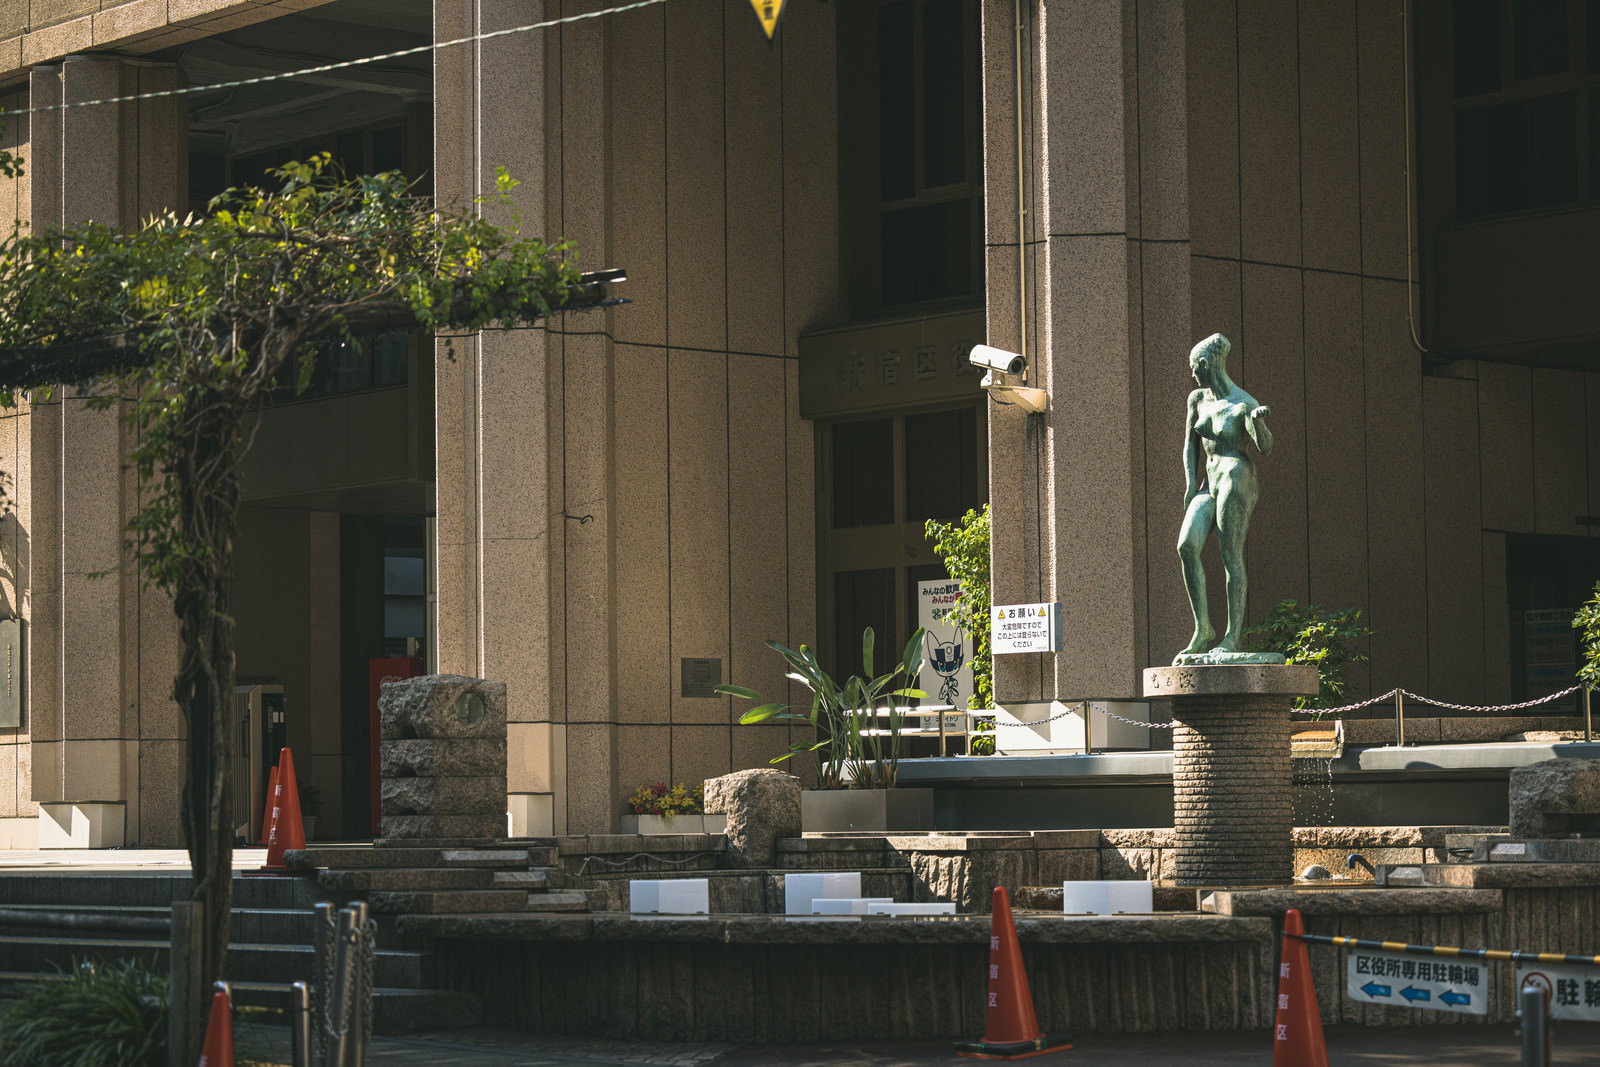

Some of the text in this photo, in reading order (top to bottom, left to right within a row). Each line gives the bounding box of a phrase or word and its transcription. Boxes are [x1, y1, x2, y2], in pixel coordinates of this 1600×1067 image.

[1008, 608, 1035, 618] お願い
[1002, 622, 1042, 630] 大変危険ですので
[997, 631, 1047, 640] この上には登らないで
[1356, 956, 1479, 986] 区役所専用駐輪場
[1277, 962, 1290, 1041] 新宿区
